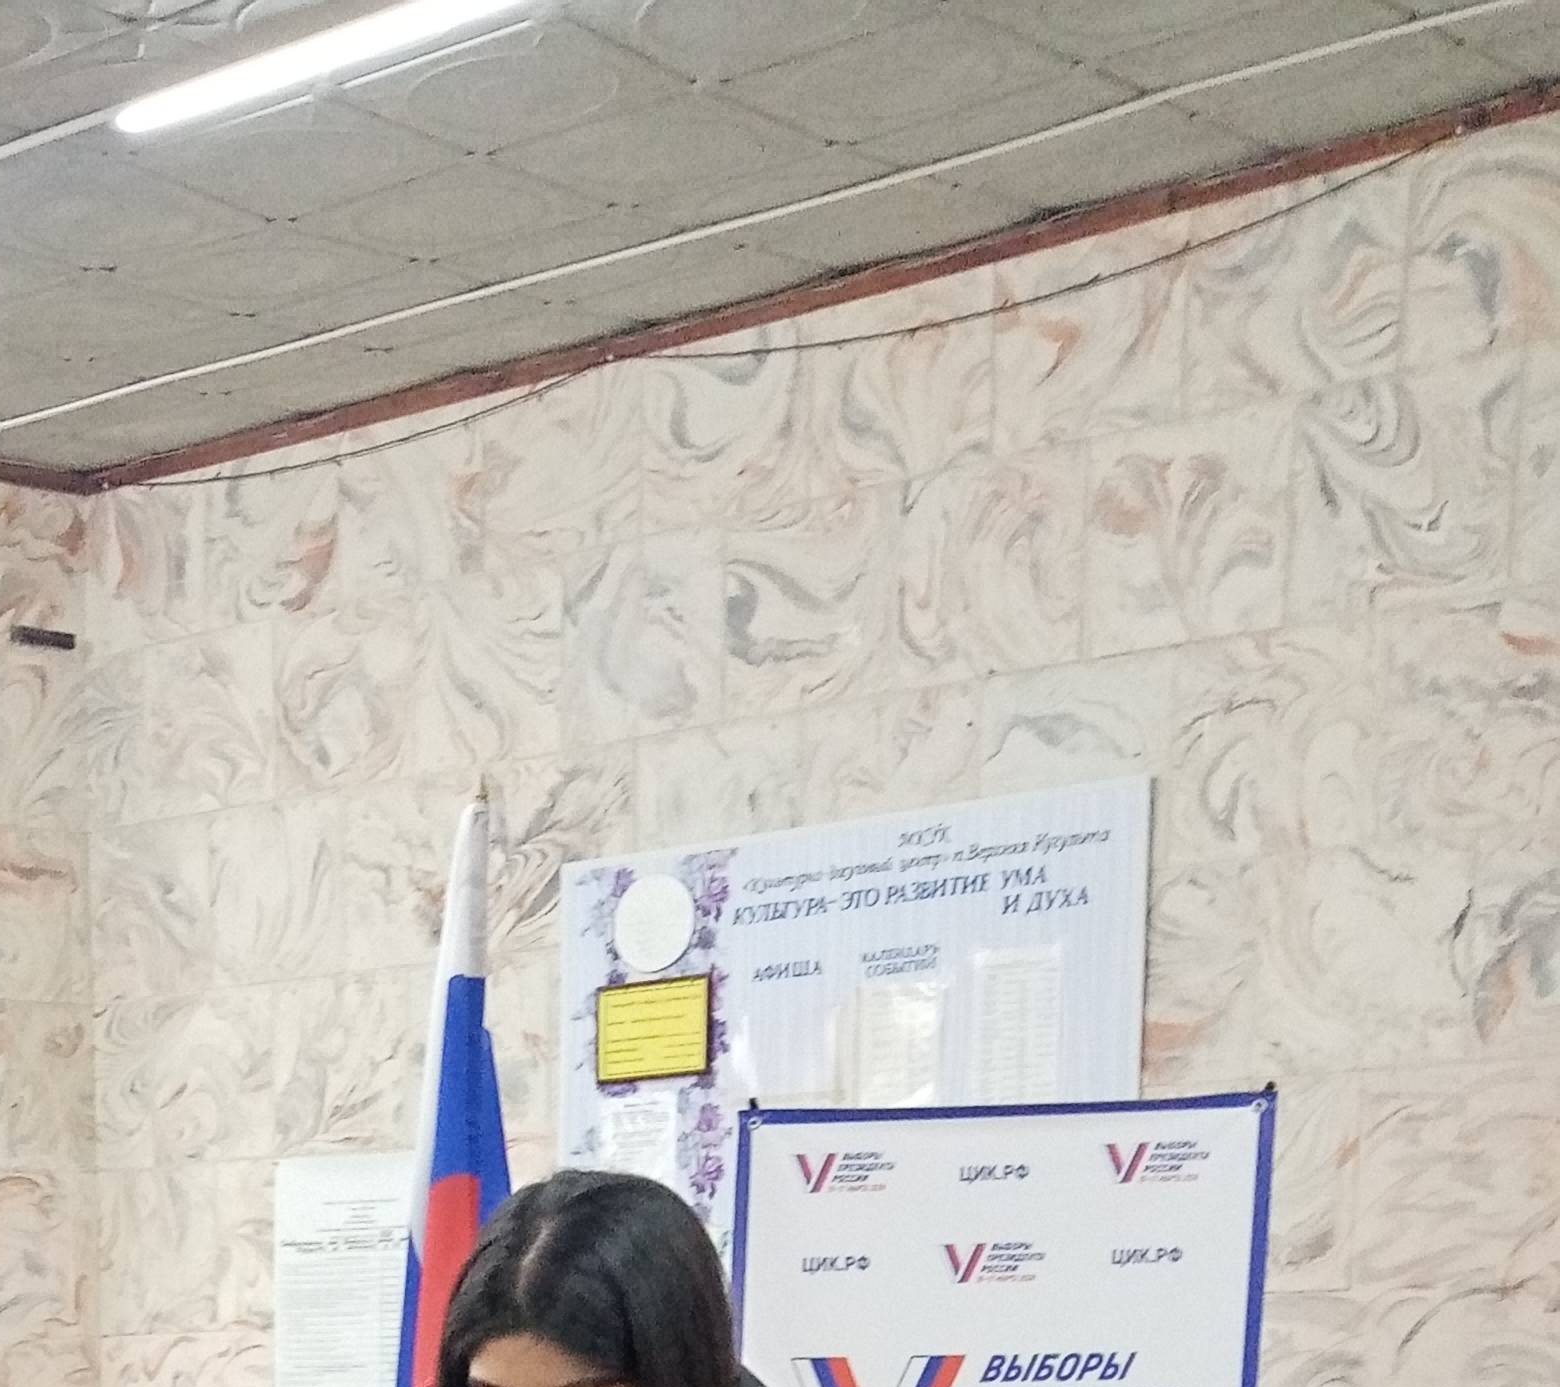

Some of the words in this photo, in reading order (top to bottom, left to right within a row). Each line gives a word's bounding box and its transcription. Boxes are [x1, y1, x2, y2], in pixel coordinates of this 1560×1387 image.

[884, 872, 991, 905] РАЗВИТИЕ
[1000, 865, 1049, 890] УМА
[1026, 886, 1089, 914] ДУХА
[958, 1164, 1030, 1184] ЦИК.РФ
[802, 1255, 871, 1275] ЦИК.РФ
[1111, 1246, 1183, 1267] ЦИК.РФ
[979, 1351, 1138, 1383] ВЫБОРЫ
